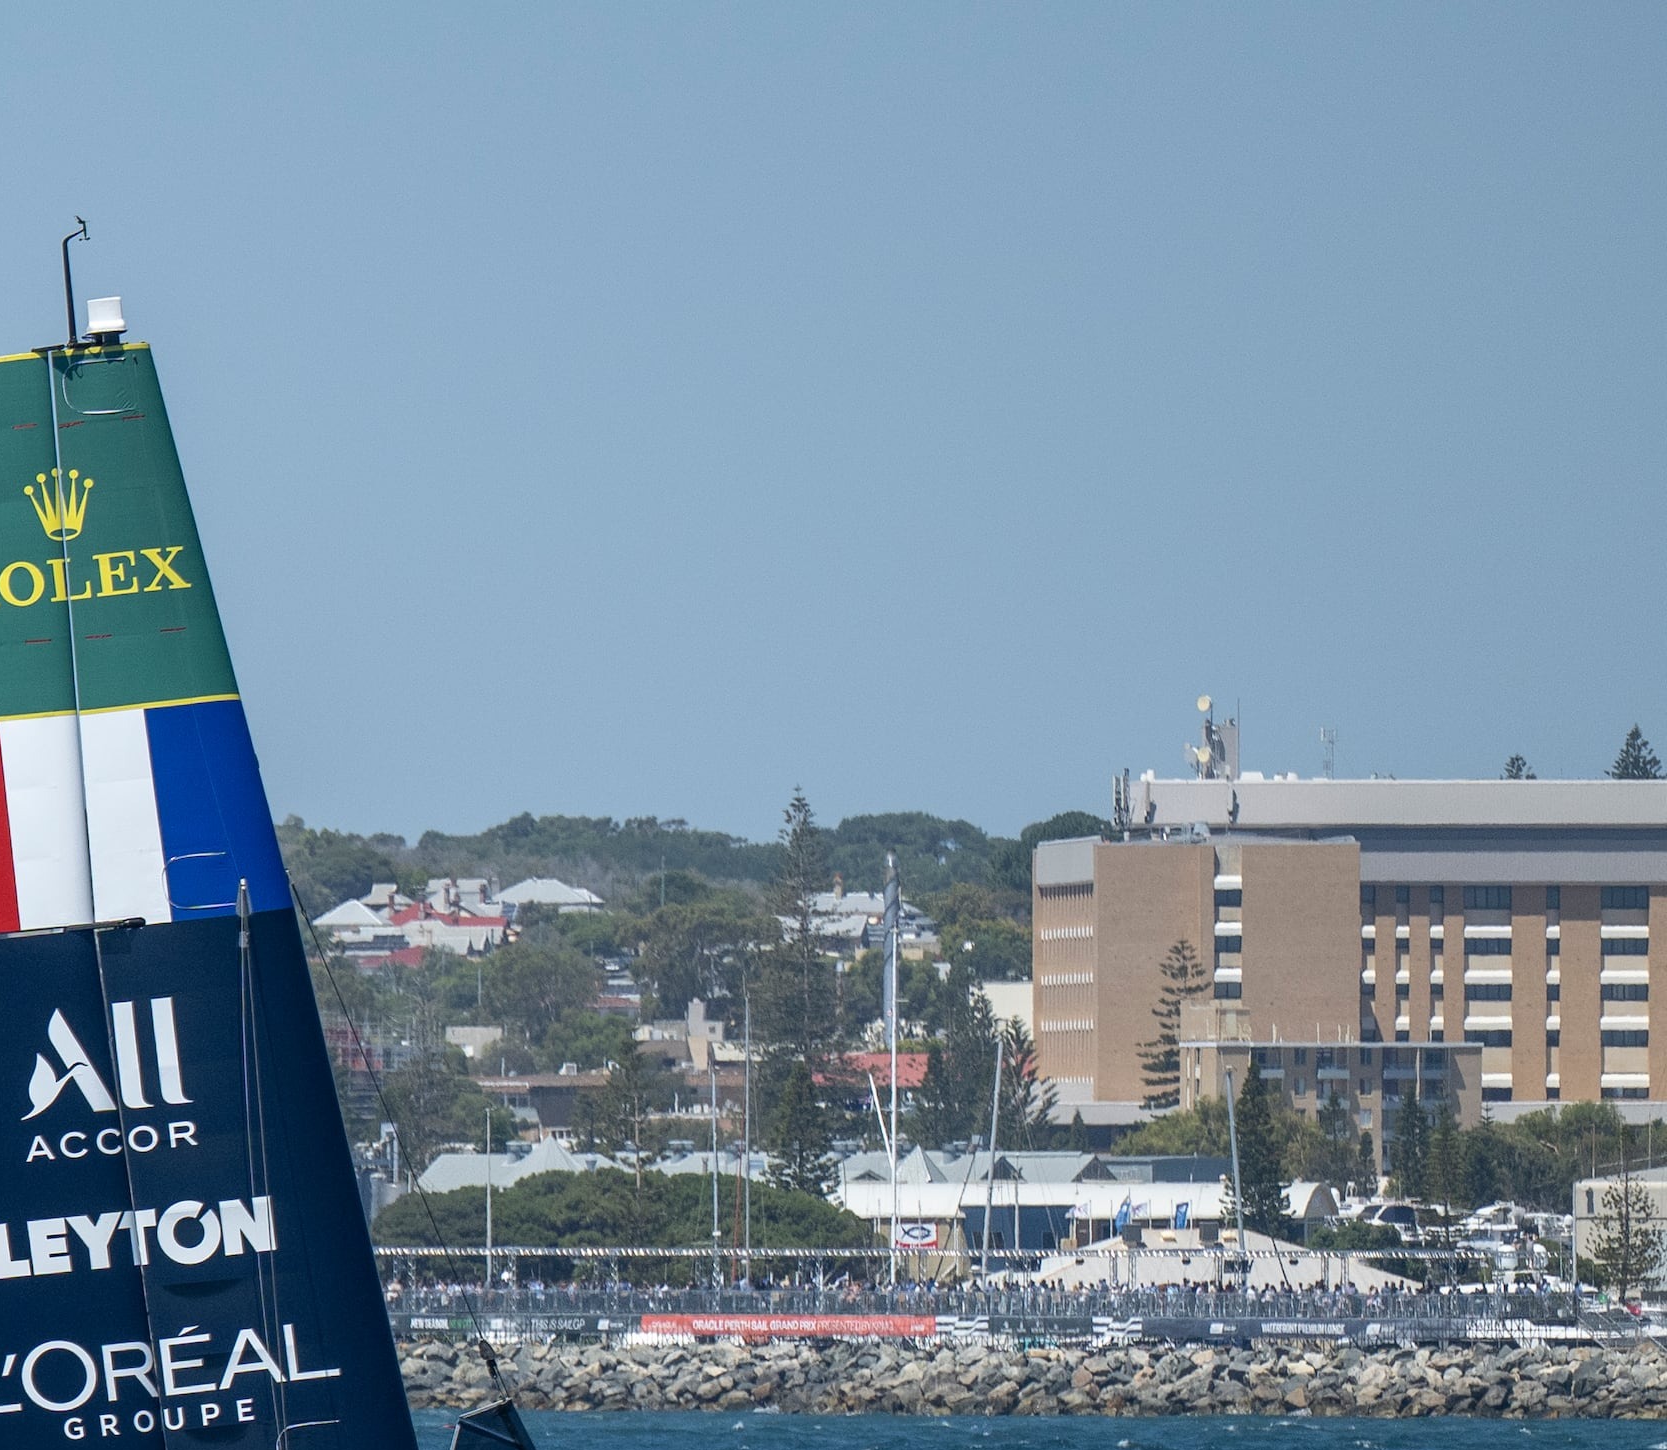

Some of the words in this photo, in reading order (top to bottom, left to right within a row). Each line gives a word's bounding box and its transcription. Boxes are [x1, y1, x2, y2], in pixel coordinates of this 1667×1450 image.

[25, 1121, 199, 1162] ACCOR
[693, 1319, 724, 1331] ORACLE
[724, 1319, 750, 1331] PERTH
[751, 1319, 768, 1331] SAIL
[770, 1319, 798, 1331] GRAND
[799, 1319, 816, 1331] PRIX
[63, 1399, 256, 1440] GROUPE
